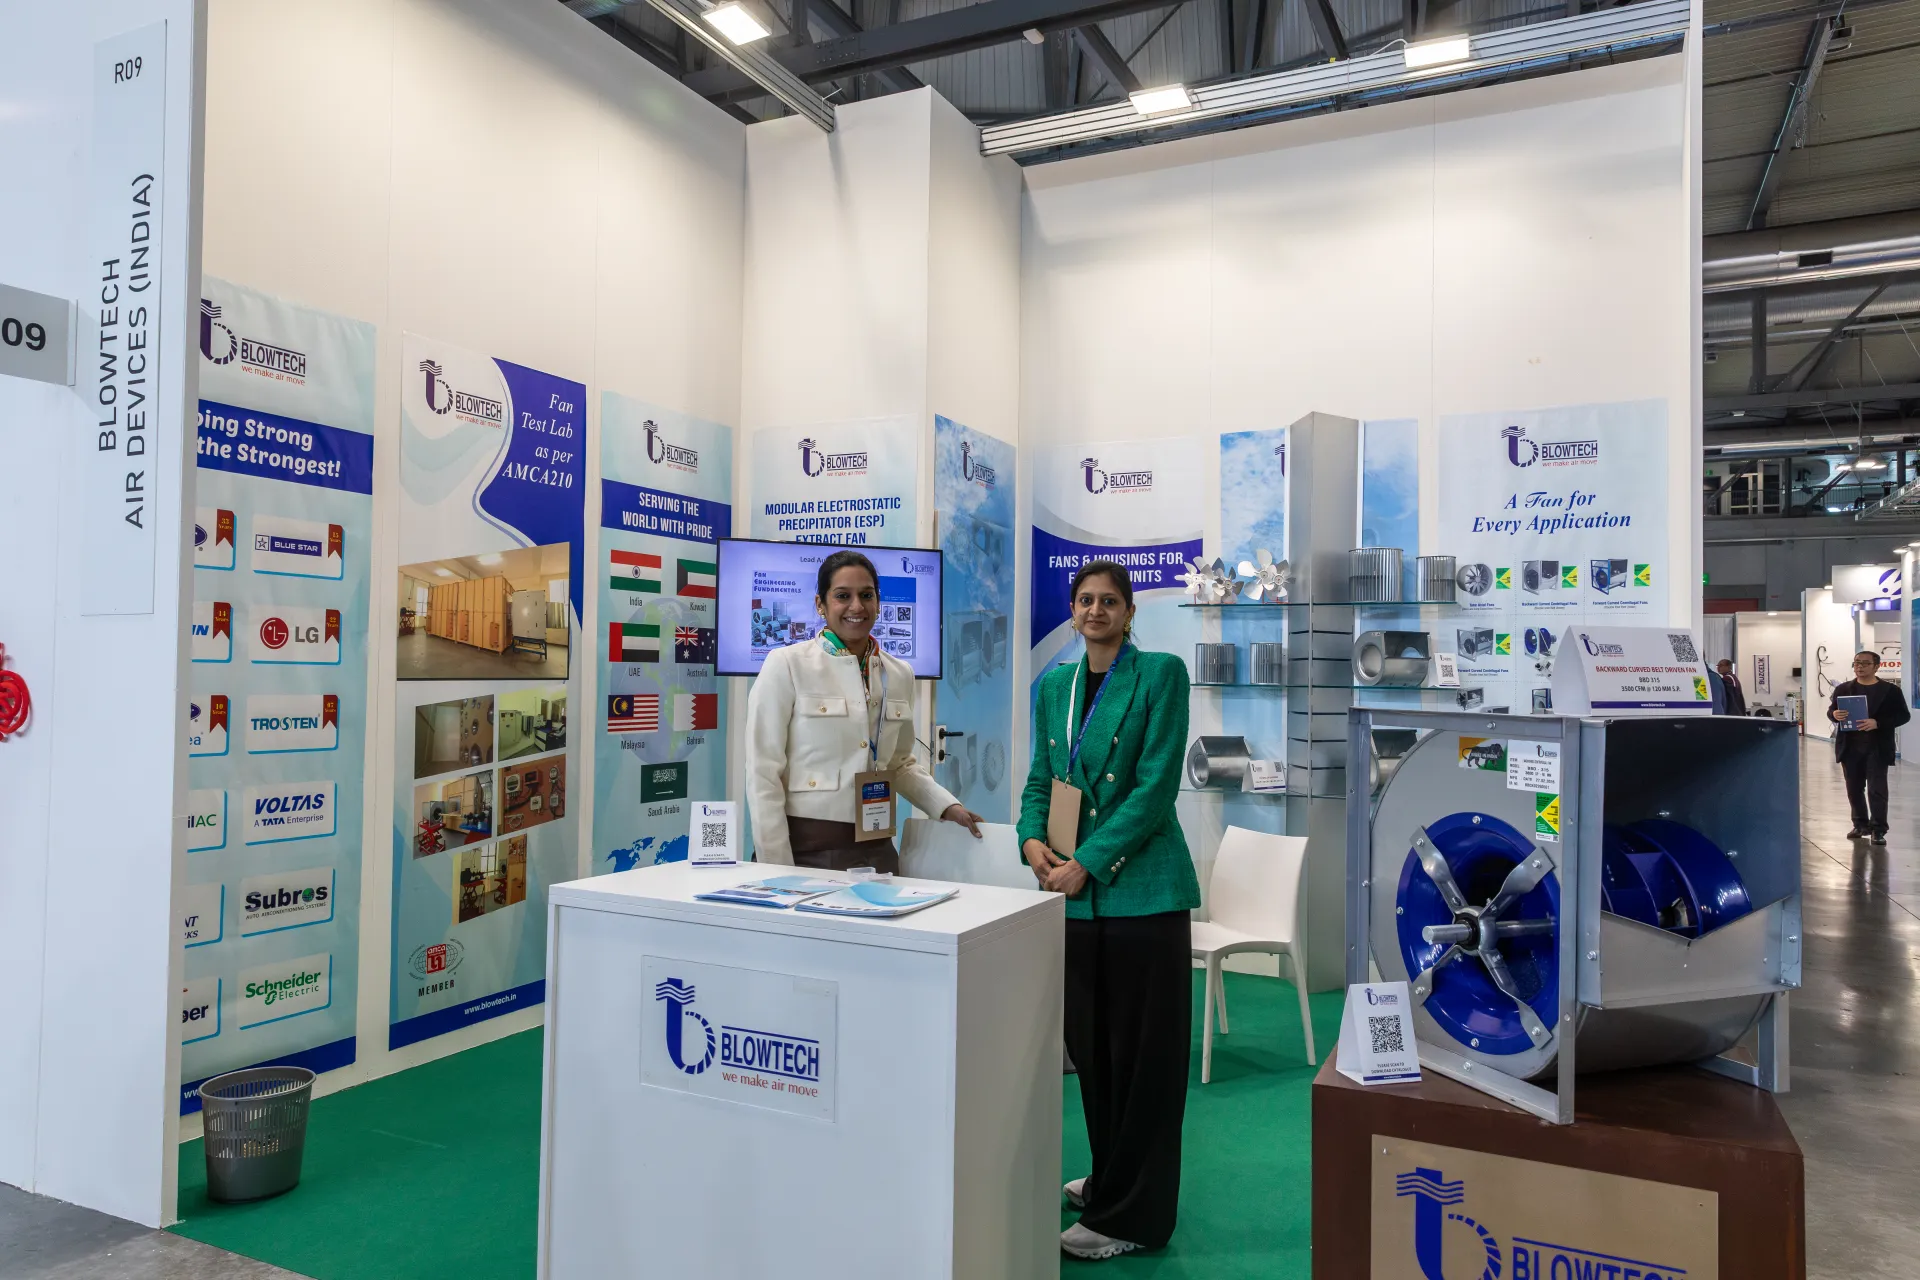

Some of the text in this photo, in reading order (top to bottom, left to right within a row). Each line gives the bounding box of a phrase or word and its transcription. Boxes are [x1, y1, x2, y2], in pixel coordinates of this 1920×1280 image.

[114, 56, 143, 84] R09
[1, 317, 46, 351] 09
[98, 257, 121, 453] BLOWTECH
[125, 172, 155, 530] AIR DEVICES (INDIA)
[241, 341, 306, 375] BLOWTECH
[241, 365, 306, 386] we make air move
[455, 394, 502, 420] BLOWTECH
[549, 393, 574, 414] Fan
[244, 418, 313, 451] Strong
[522, 411, 573, 439] Test Lab
[197, 436, 341, 478] the Strongest!
[535, 446, 573, 465] as per
[666, 447, 698, 466] BLOWTECH
[1541, 443, 1598, 459] BLOWTECH
[826, 454, 868, 469] BLOWTECH
[502, 461, 573, 489] AMCA210
[1110, 473, 1153, 487] BLOWTECH
[639, 492, 700, 517] SERVING THE
[765, 497, 901, 516] MODULAR ELECTROSTATIC
[1504, 490, 1597, 511] A Fan for
[622, 510, 713, 540] WORLD WITH PRIDE
[778, 513, 885, 531] PRECIPITATOR (ESP)
[1472, 512, 1632, 536] Every Application
[274, 541, 319, 552] BLUE STAR
[796, 532, 866, 545] EXTRACT FAN
[1049, 555, 1079, 568] FANS
[1159, 552, 1184, 565] FOR
[629, 596, 643, 607] India
[689, 602, 707, 612] Kuwait
[294, 626, 319, 643] LG
[628, 667, 641, 677] UAE
[687, 668, 708, 678] Australia
[251, 716, 319, 731] TROSTEN
[620, 740, 645, 751] Malaysia
[686, 736, 705, 746] Bahrain
[254, 793, 325, 815] VOLTAS
[647, 805, 680, 817] Saudi Arabia
[254, 813, 324, 827] A TATA Enterprise
[245, 886, 328, 912] Subros
[245, 971, 322, 999] Schneider
[279, 985, 320, 1001] Electric
[418, 979, 455, 997] MEMBER
[464, 993, 517, 1015] www.blowtech.in
[721, 1032, 820, 1078] BLOWTECH
[722, 1071, 818, 1098] we make air move
